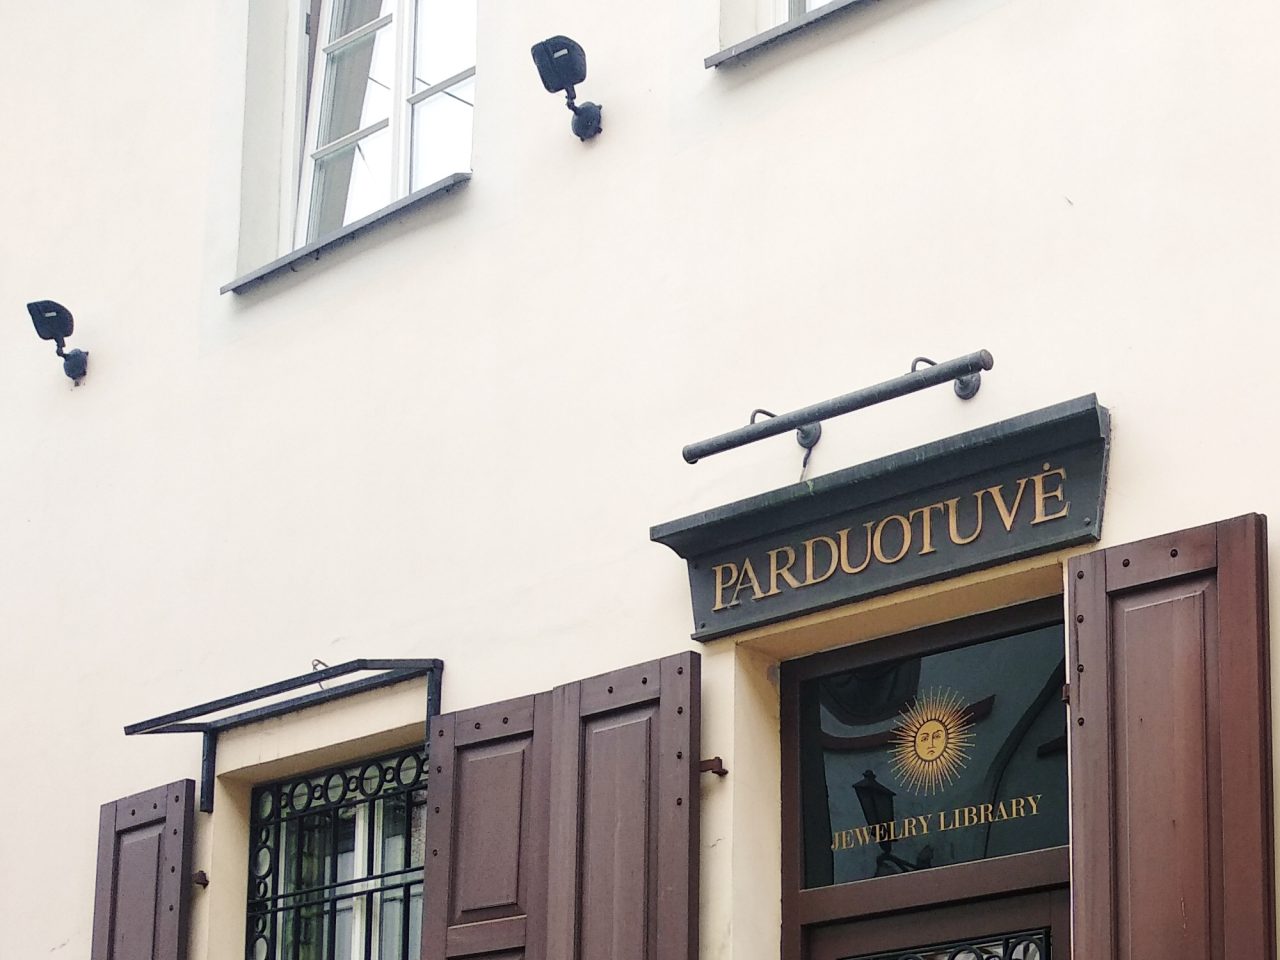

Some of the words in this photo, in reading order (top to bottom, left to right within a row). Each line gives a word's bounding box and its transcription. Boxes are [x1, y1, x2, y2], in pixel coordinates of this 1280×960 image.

[712, 462, 1072, 612] PARDUOTUVĖ
[831, 814, 932, 850] JEWELRY
[938, 794, 1042, 832] LIBRARY
